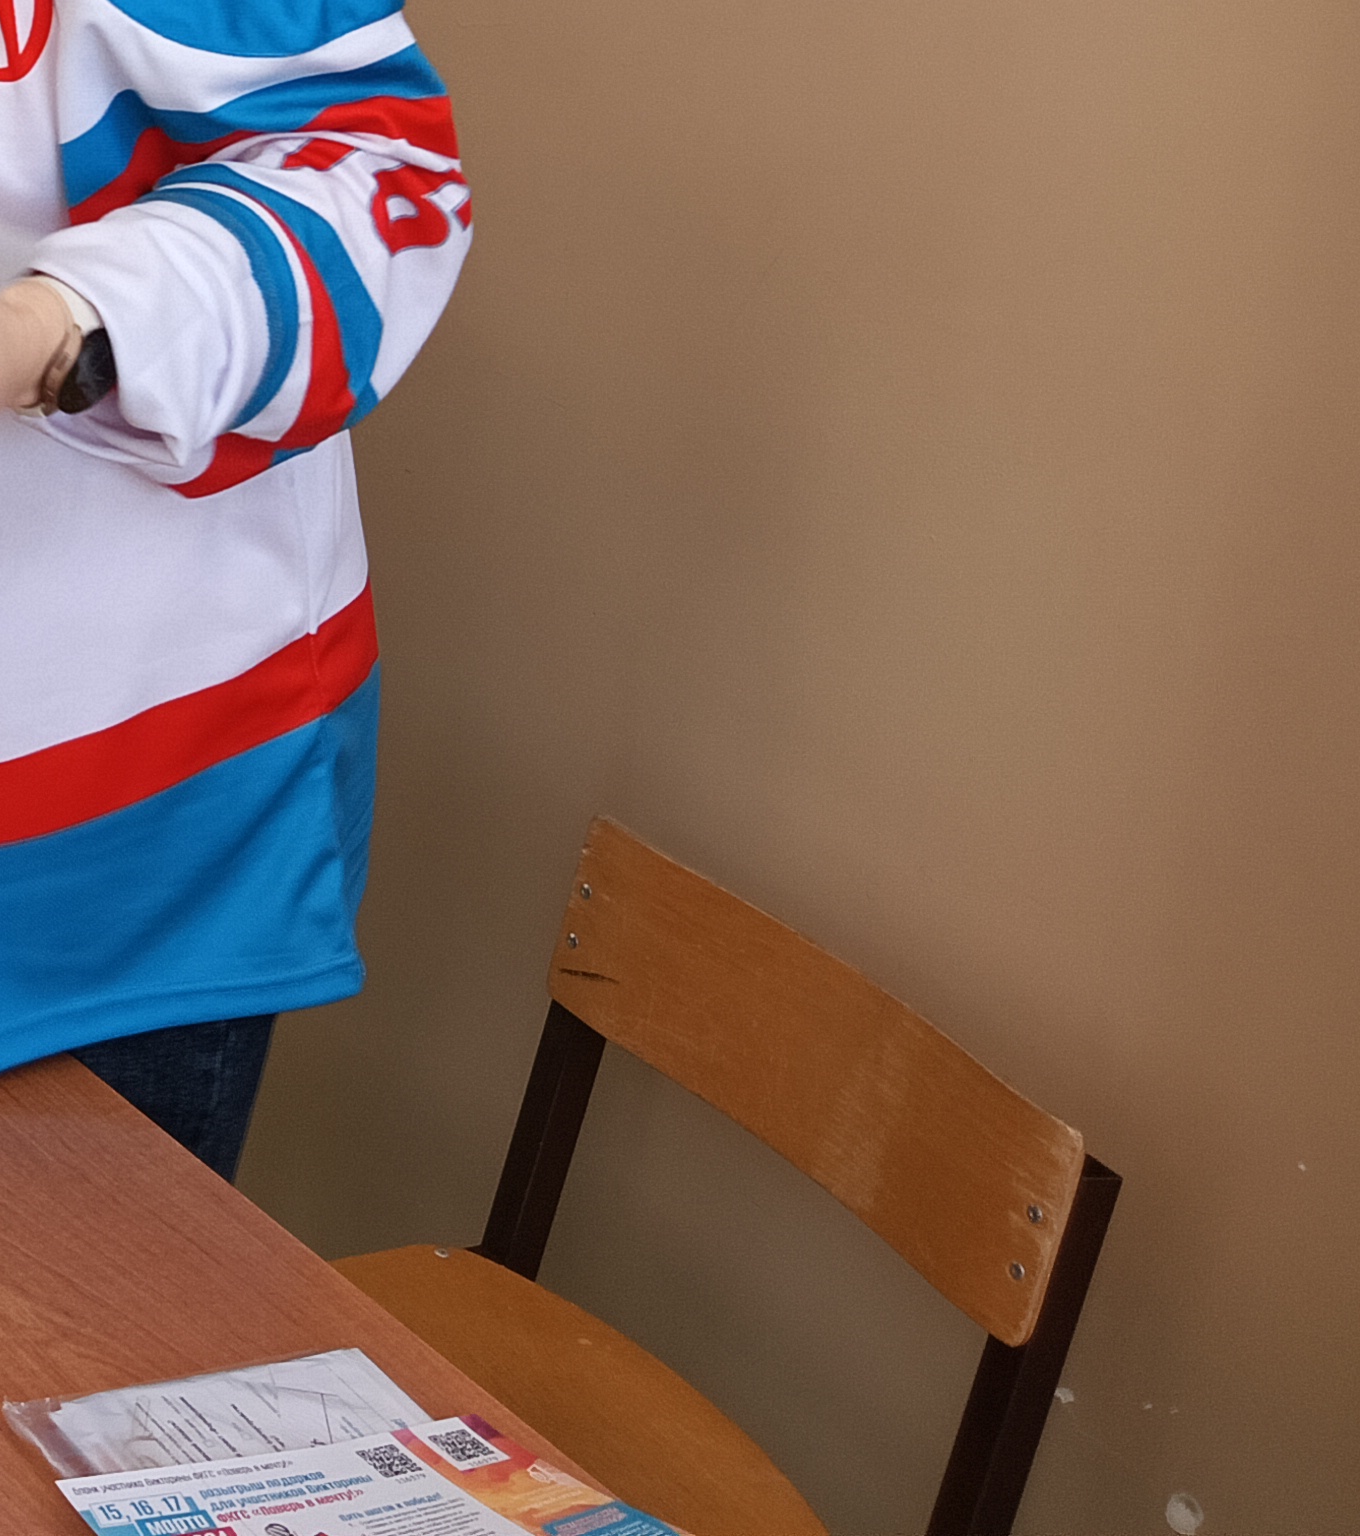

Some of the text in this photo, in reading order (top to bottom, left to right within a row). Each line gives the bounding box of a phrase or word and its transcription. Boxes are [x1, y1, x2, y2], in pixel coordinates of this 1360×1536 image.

[199, 1471, 325, 1500] розыгрыш подарков
[210, 1474, 373, 1513] для участников Викторины
[161, 1495, 182, 1513] 17
[216, 1509, 251, 1523] ФКГС
[305, 1497, 316, 1507] в
